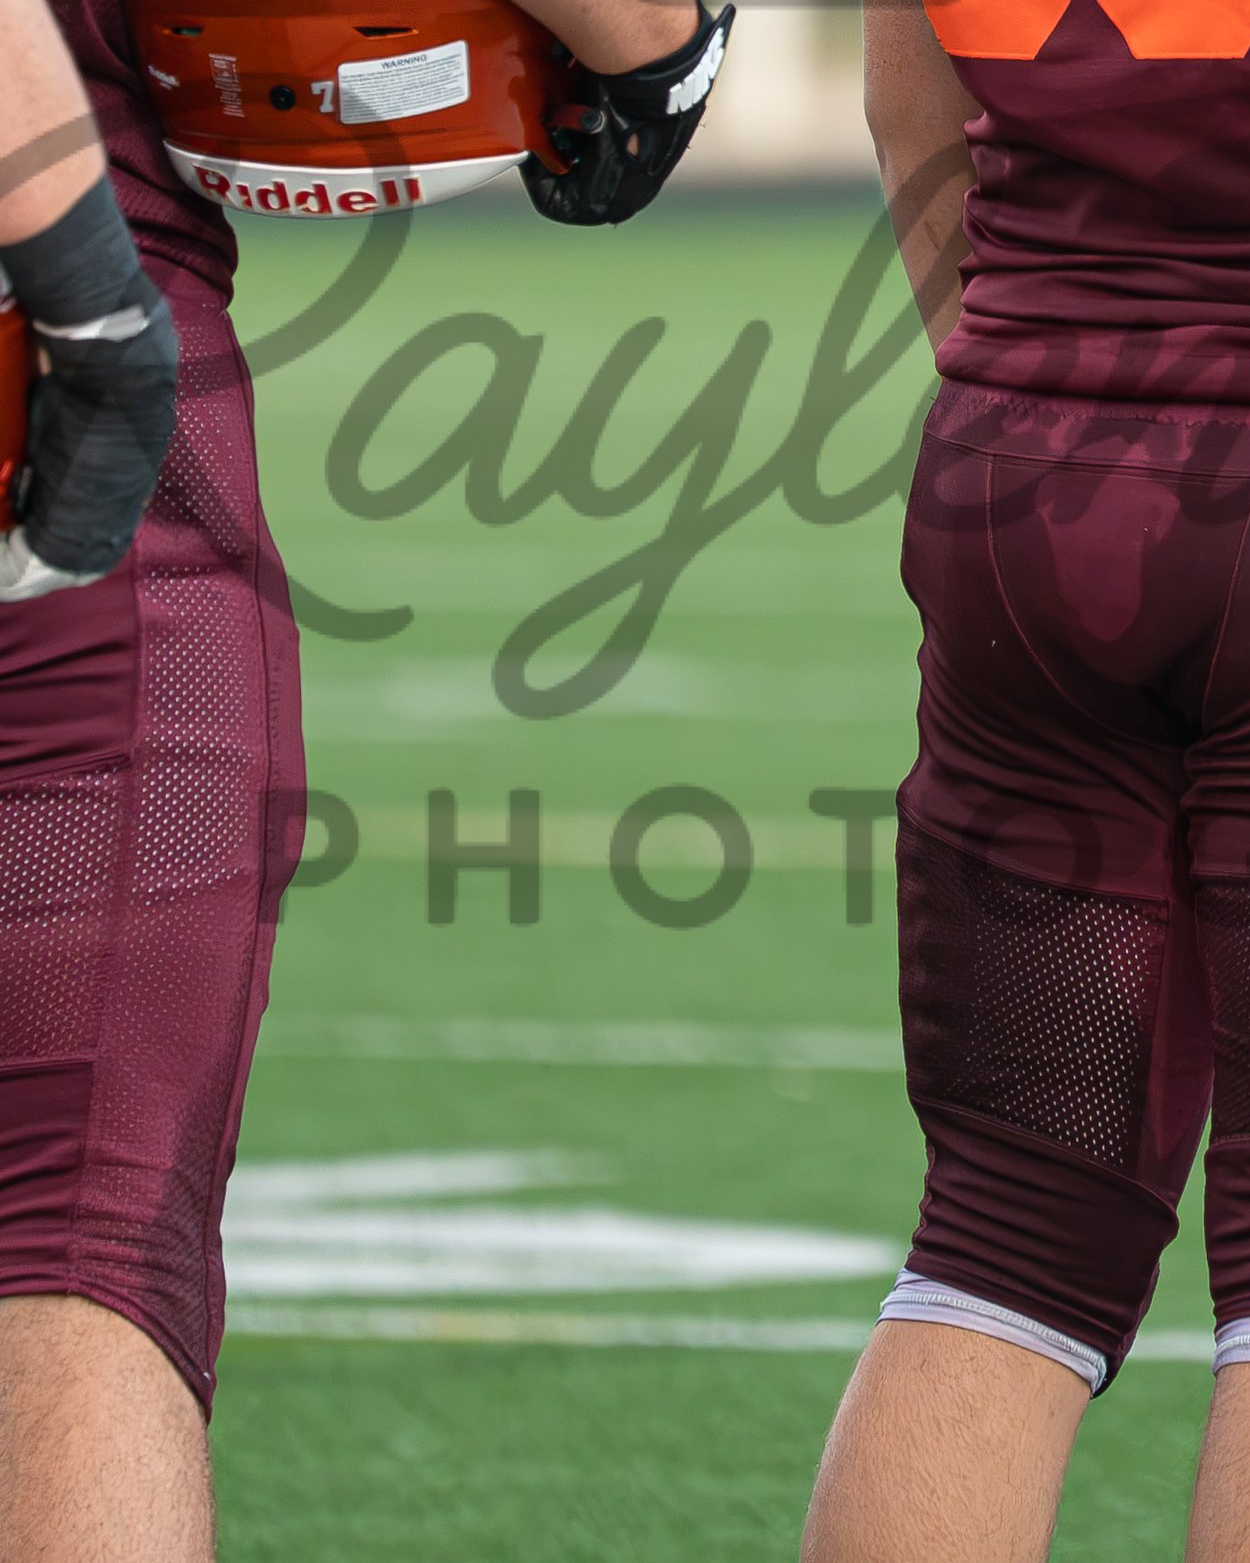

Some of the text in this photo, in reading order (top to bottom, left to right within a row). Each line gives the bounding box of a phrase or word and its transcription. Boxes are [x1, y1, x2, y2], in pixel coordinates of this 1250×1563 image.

[381, 54, 428, 69] WARNING
[310, 80, 336, 113] 7
[192, 163, 422, 215] Riddell
